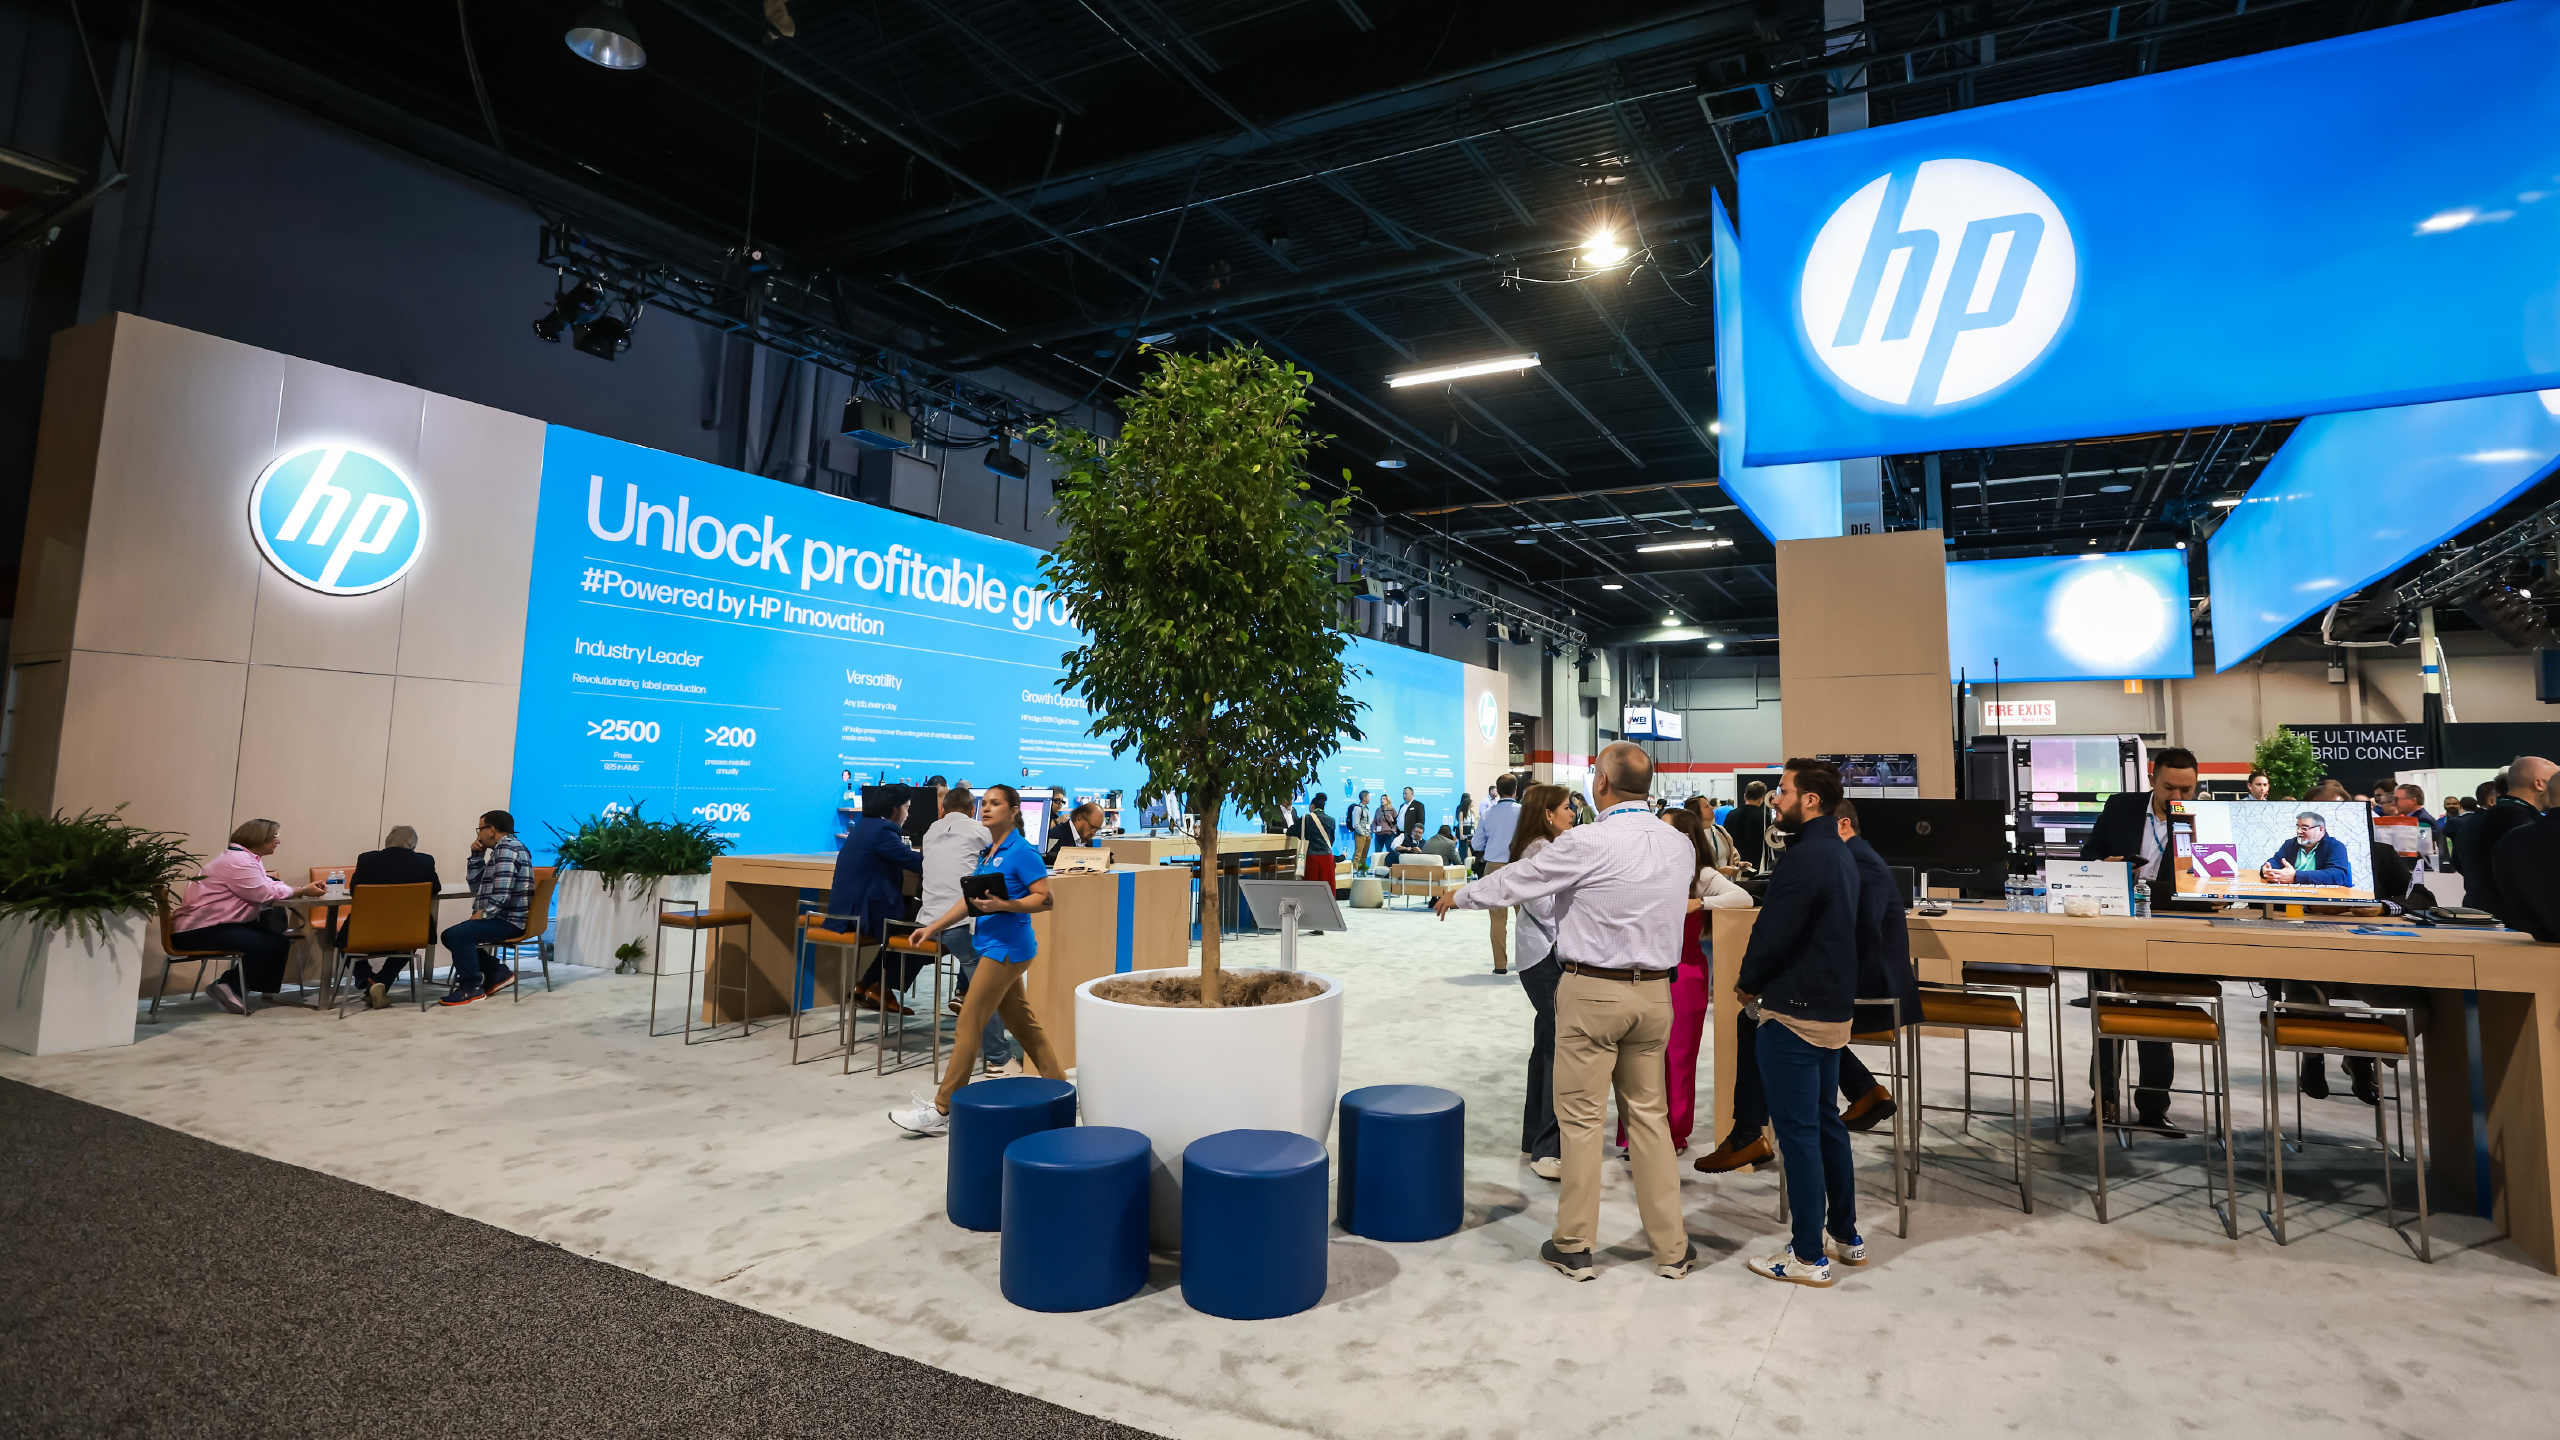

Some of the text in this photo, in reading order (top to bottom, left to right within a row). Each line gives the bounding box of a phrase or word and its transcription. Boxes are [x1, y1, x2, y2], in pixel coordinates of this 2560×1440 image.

[1831, 159, 2046, 407] hp
[274, 447, 409, 588] hp
[587, 474, 793, 575] Unlock
[800, 537, 1007, 614] profitable
[580, 566, 885, 636] #Powered by HP Innovation
[574, 637, 704, 668] Industry Leader
[572, 672, 707, 695] Revolutionizing label production
[846, 668, 903, 691] Versatility
[843, 698, 857, 708] Any
[868, 701, 886, 711] every
[885, 701, 898, 712] day
[1021, 689, 1107, 711] Growth Opportu
[1987, 703, 2052, 717] FIRE EXITS
[586, 718, 661, 744] >2500
[704, 725, 757, 748] >200
[2324, 729, 2408, 744] ULTIMATE
[613, 751, 633, 760] Press
[2311, 746, 2350, 760] BRID
[603, 762, 617, 771] 925
[622, 763, 640, 772] AMS
[1917, 821, 1930, 835] hp
